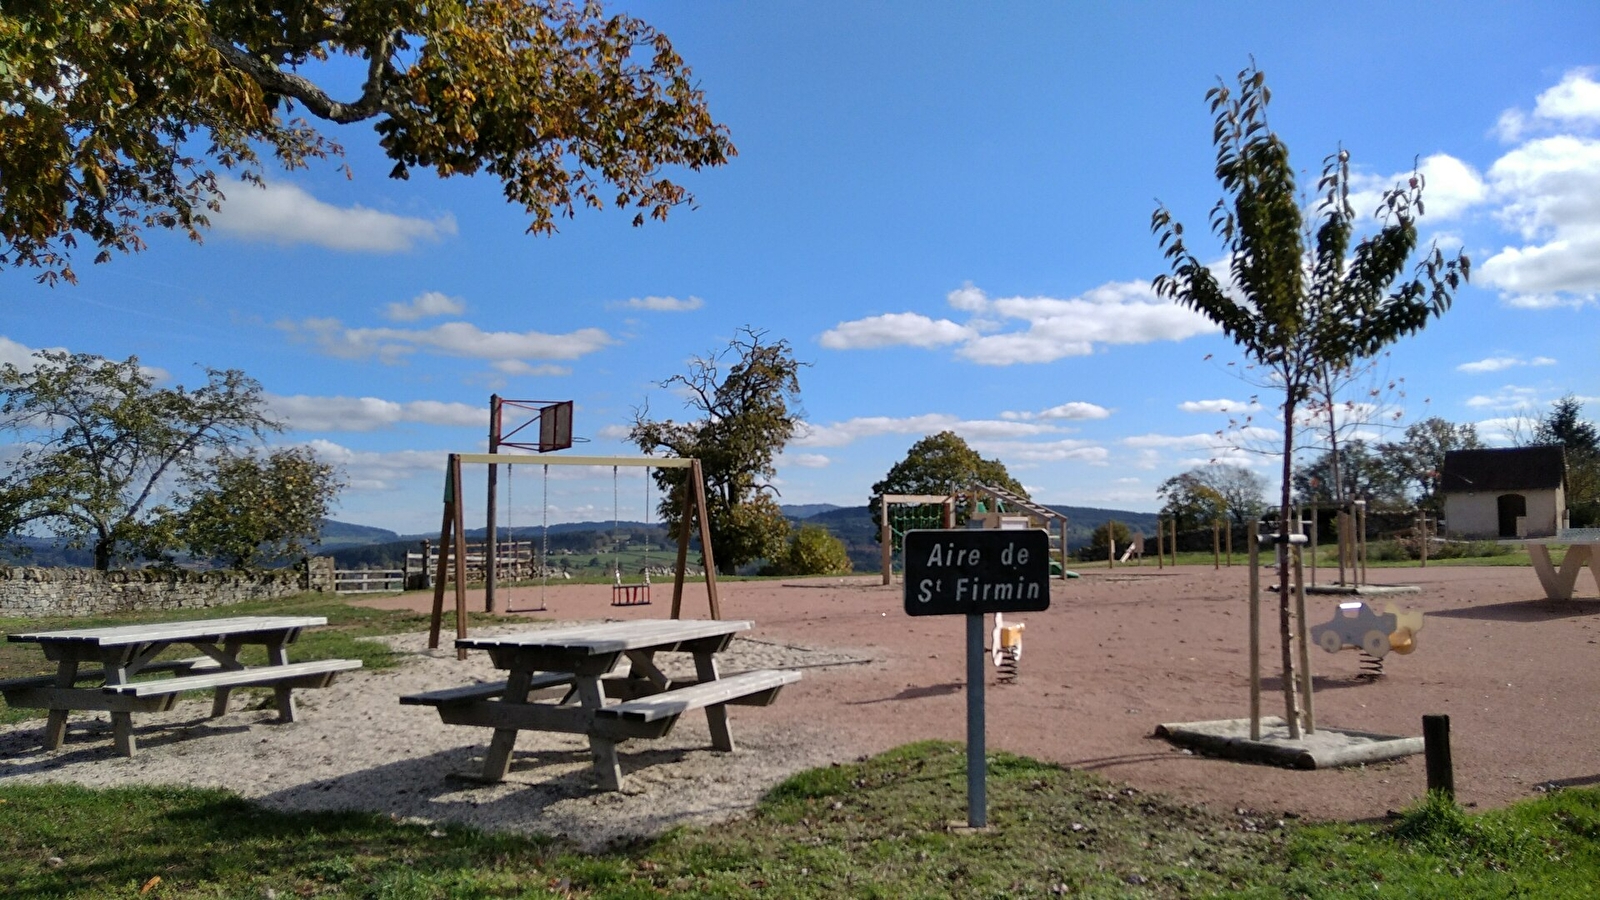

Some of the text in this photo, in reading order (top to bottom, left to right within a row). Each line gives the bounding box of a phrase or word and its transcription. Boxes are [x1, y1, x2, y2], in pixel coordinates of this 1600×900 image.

[926, 542, 1029, 567] Aire de
[955, 576, 1040, 601] Firmin
